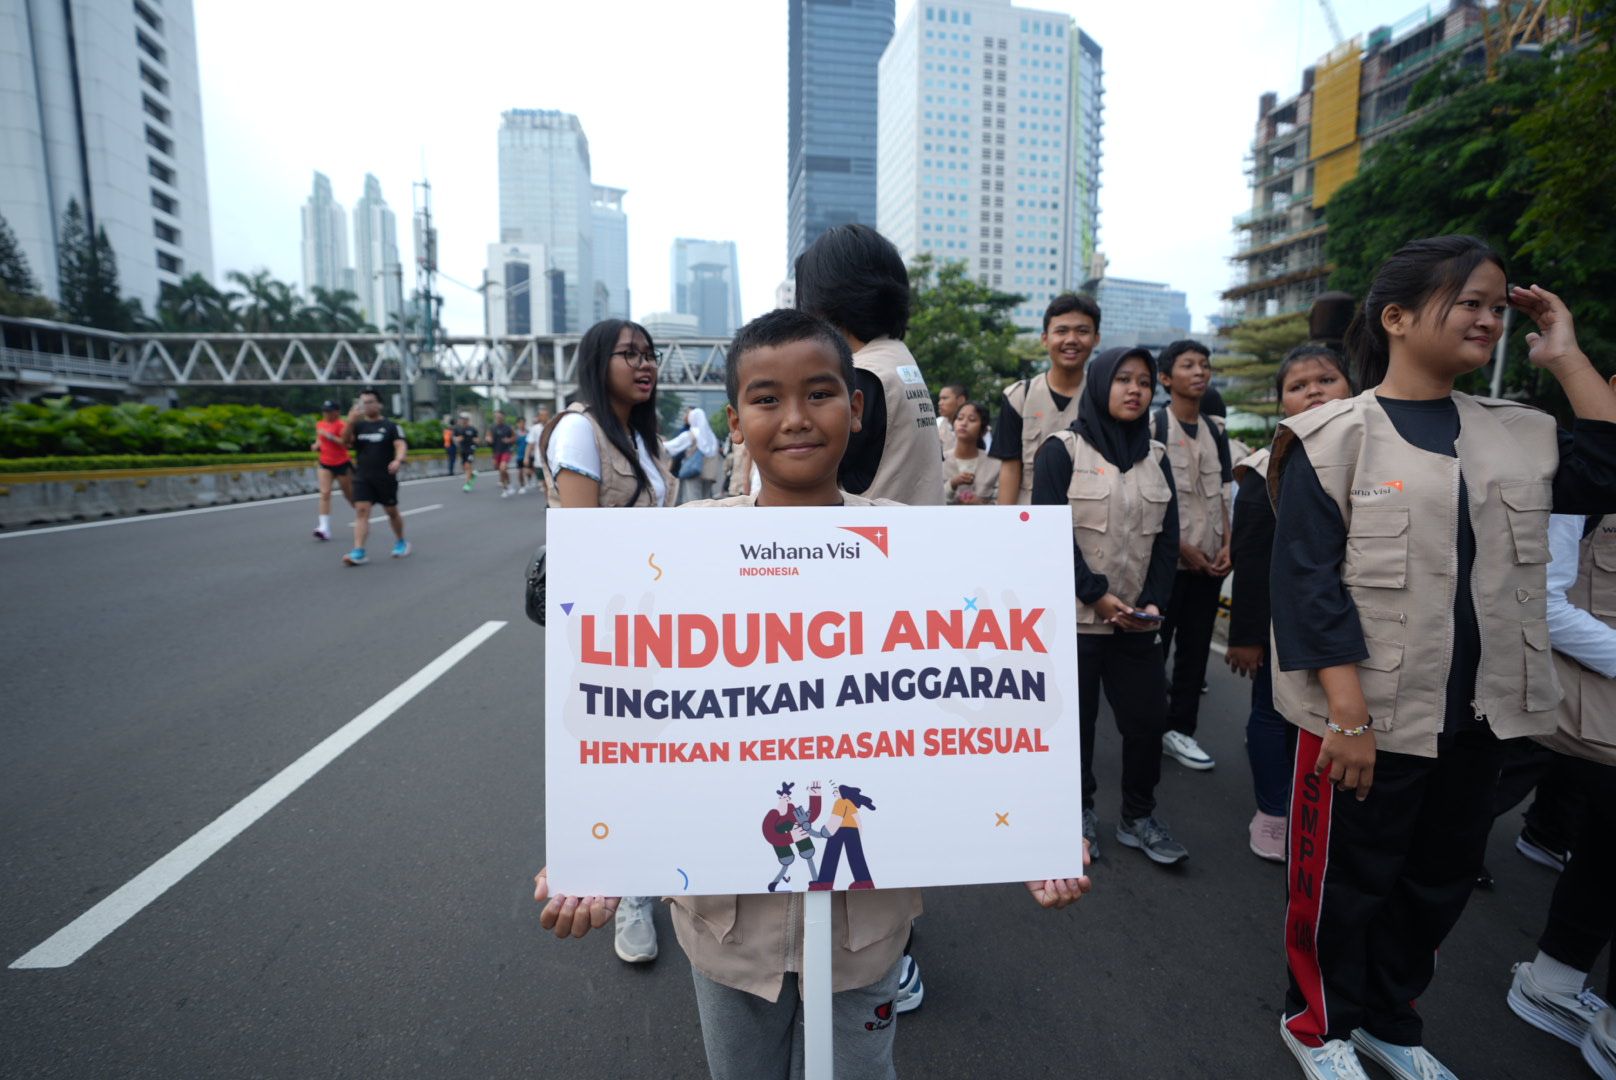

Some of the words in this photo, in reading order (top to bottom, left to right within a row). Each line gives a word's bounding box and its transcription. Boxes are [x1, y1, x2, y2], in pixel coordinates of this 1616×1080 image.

[739, 567, 799, 576] INDONESIA
[740, 542, 823, 560] Wahana
[827, 542, 860, 559] Visi
[580, 611, 864, 669] LINDUNGI
[880, 607, 1048, 653] ANAK
[579, 678, 825, 720] TINGKATKAN
[835, 666, 1046, 707] ANGGARAN
[580, 740, 730, 764] HENTIKAN
[739, 729, 915, 762] KEKERASAN
[923, 727, 1049, 757] SEKSUAL
[1297, 773, 1321, 899] SMPN
